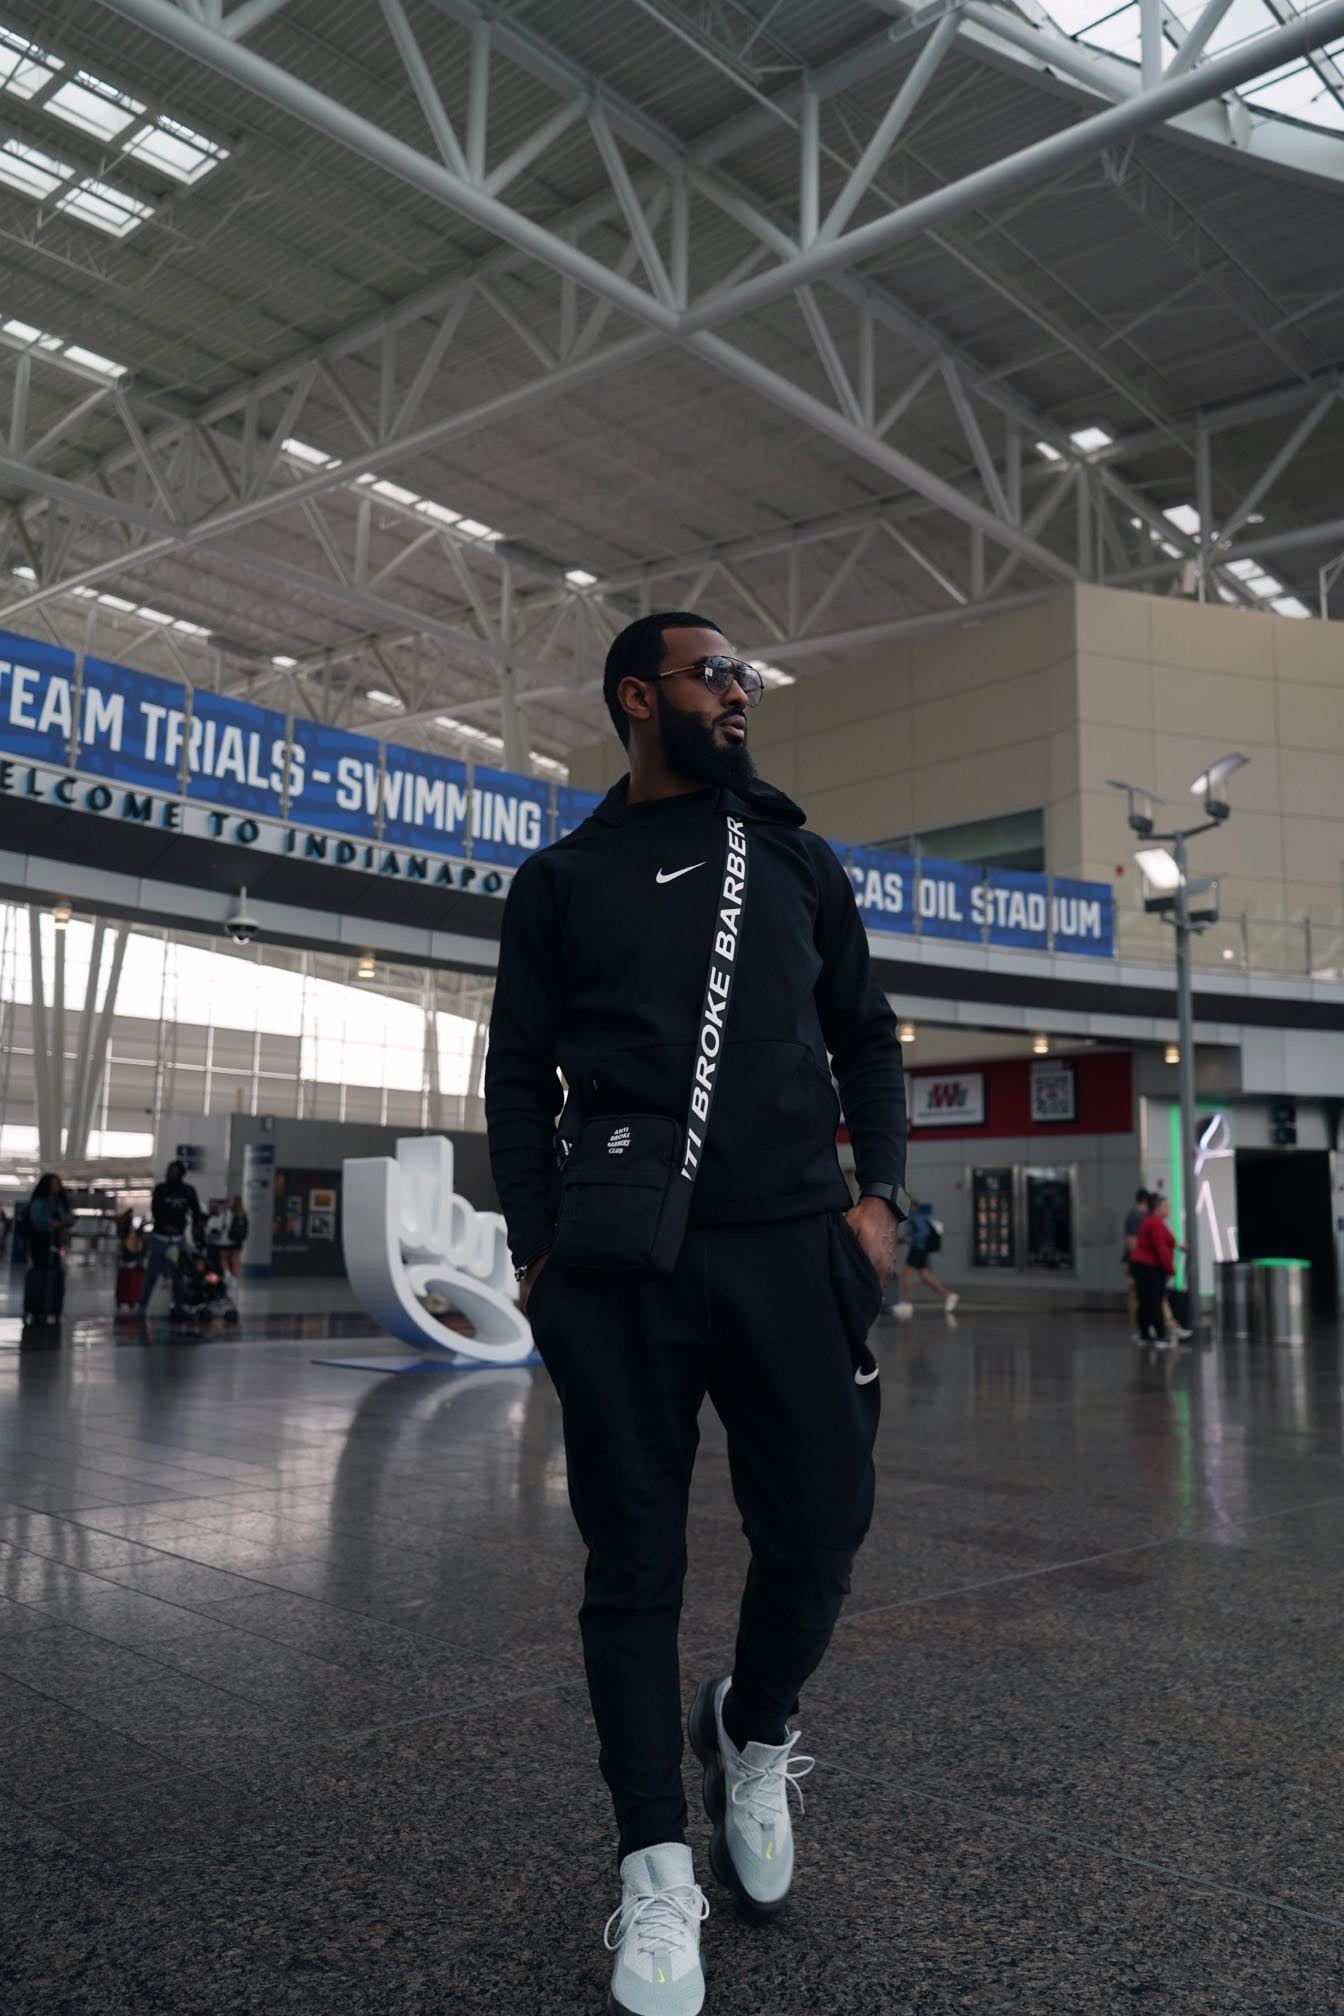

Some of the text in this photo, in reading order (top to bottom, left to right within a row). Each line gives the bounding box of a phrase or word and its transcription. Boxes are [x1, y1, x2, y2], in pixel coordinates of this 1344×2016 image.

[140, 702, 306, 797] TRIALS
[336, 757, 542, 849] SWIMMING
[210, 810, 260, 844] TO
[285, 829, 511, 893] INDIANAPO
[847, 866, 1101, 939] CAS OIL STADIUM
[692, 968, 731, 1123] BROKE
[714, 815, 746, 962] BARBER
[614, 1126, 630, 1135] ANTI
